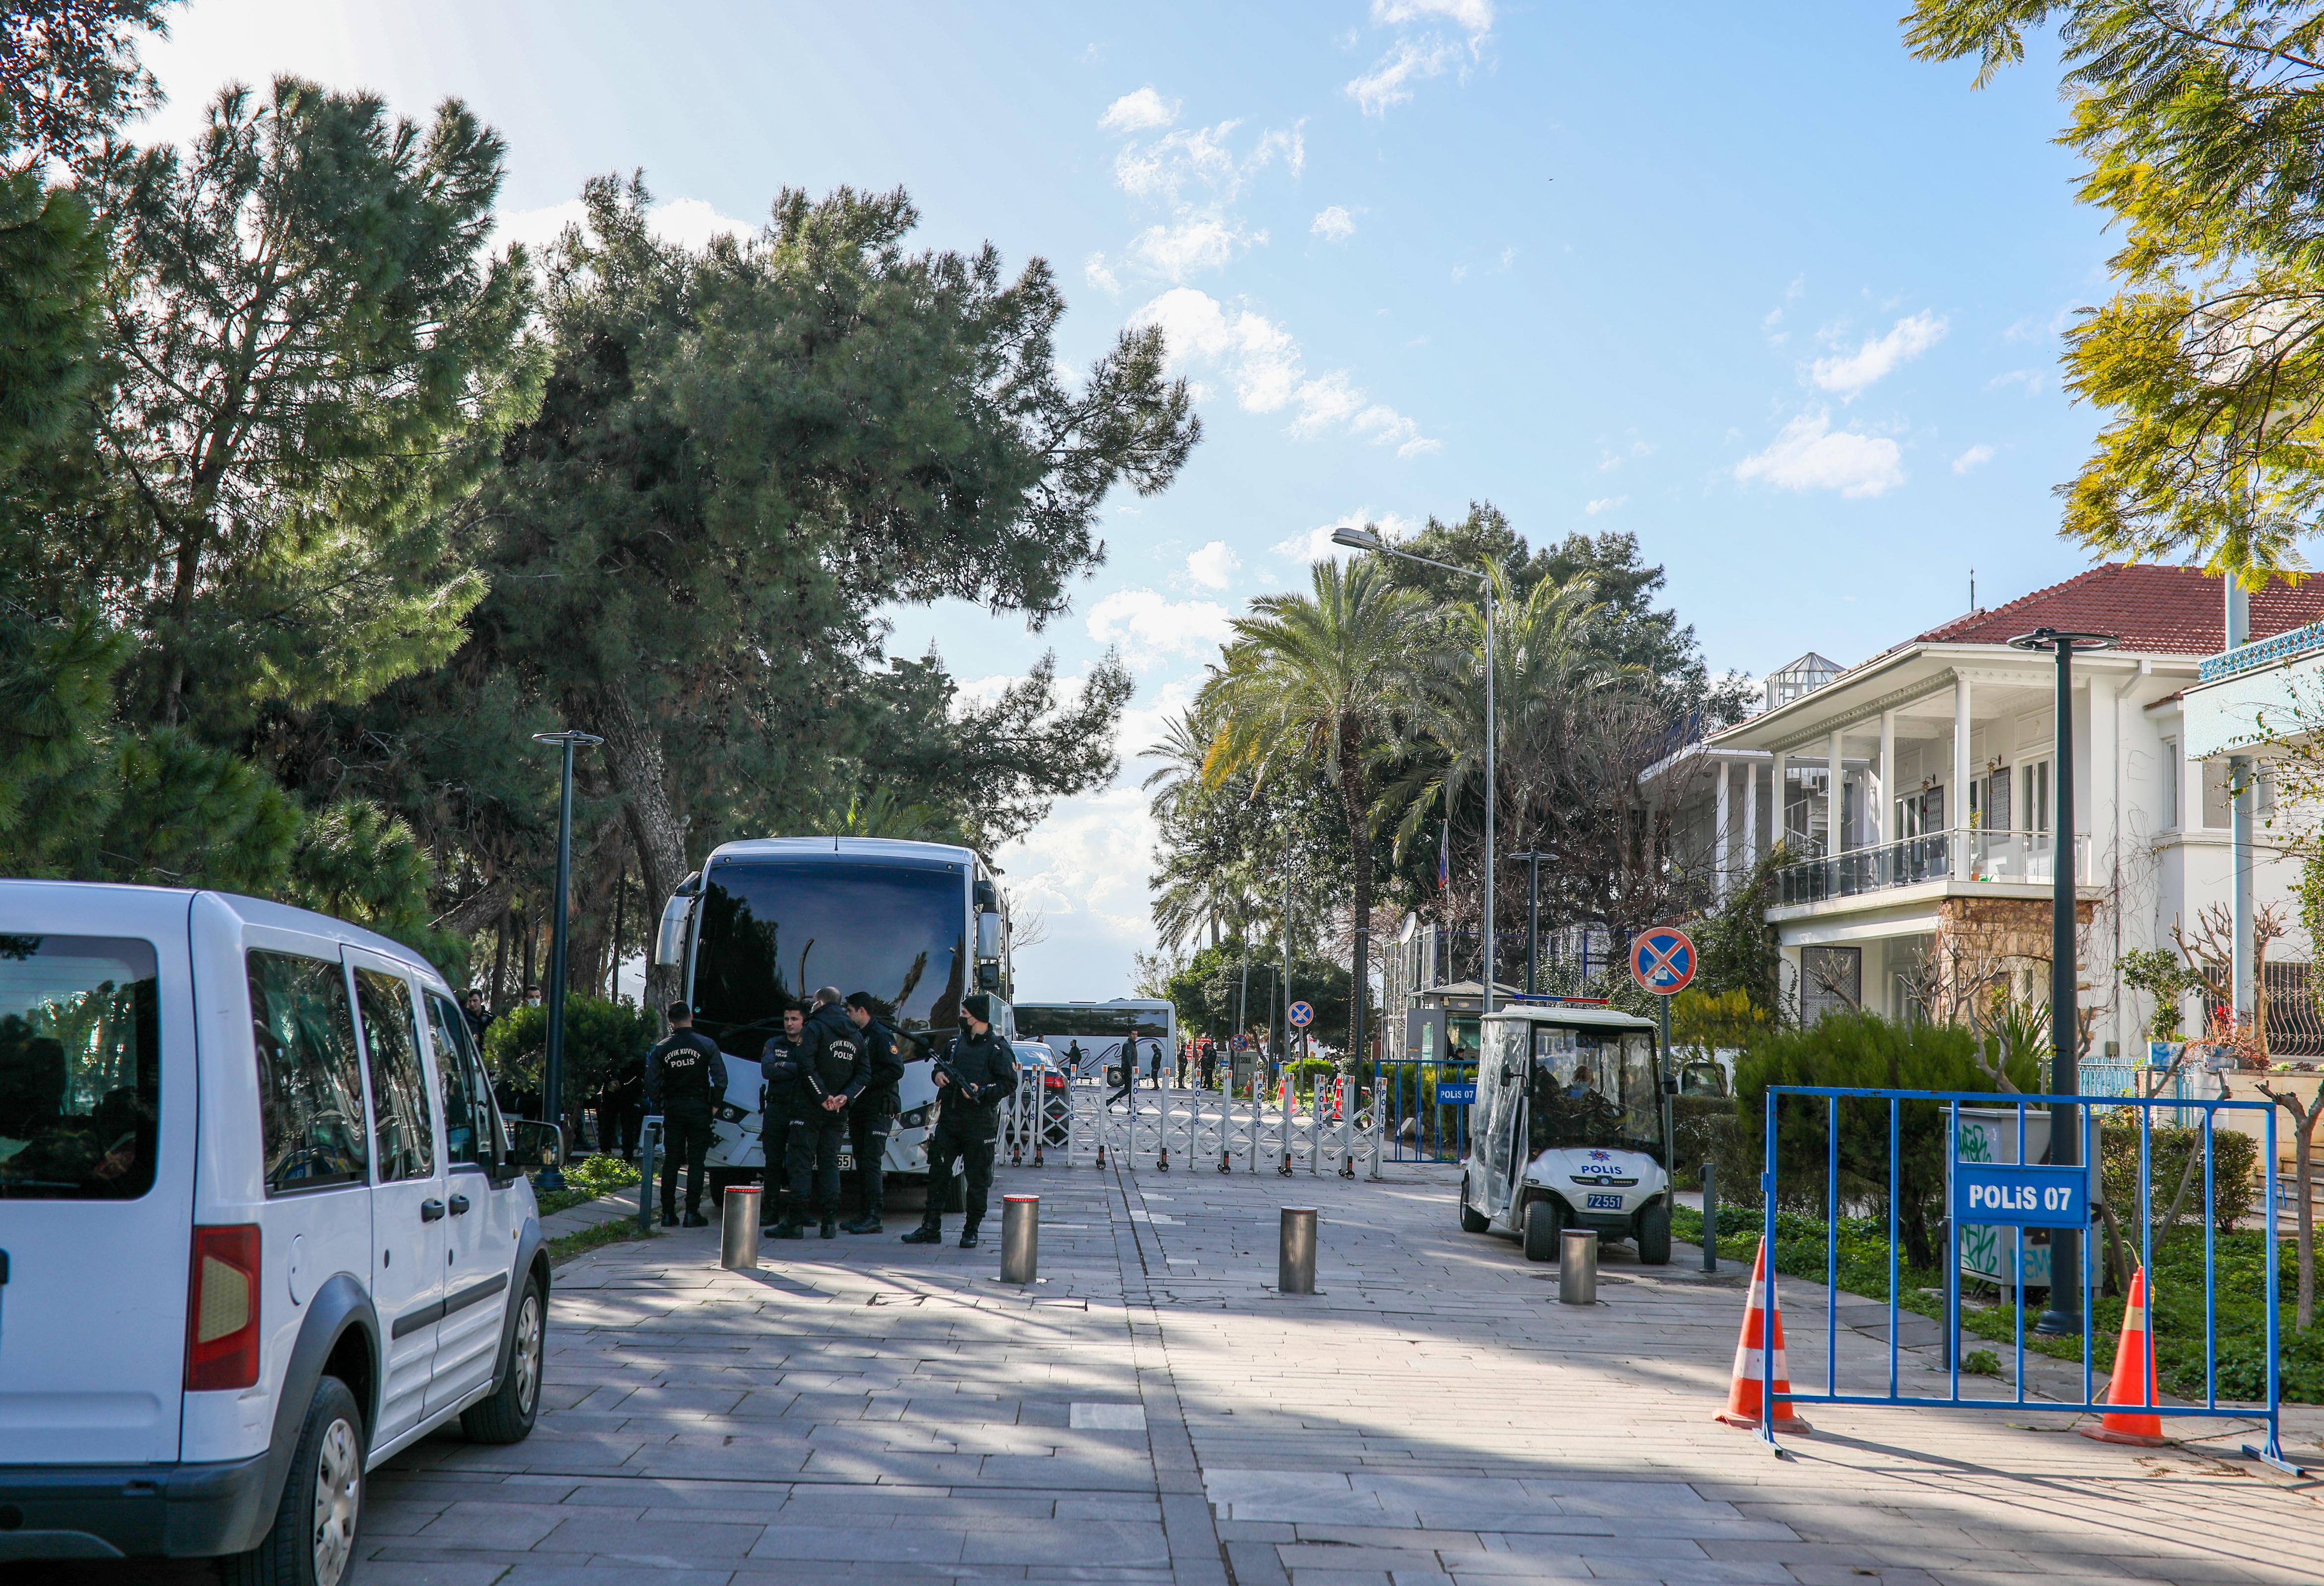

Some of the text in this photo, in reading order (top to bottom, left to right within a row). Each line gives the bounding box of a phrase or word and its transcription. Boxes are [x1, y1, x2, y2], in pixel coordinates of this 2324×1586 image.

[680, 1048, 701, 1059] KUVVET
[1464, 1090, 1474, 1099] 07
[2044, 1187, 2072, 1211] 07
